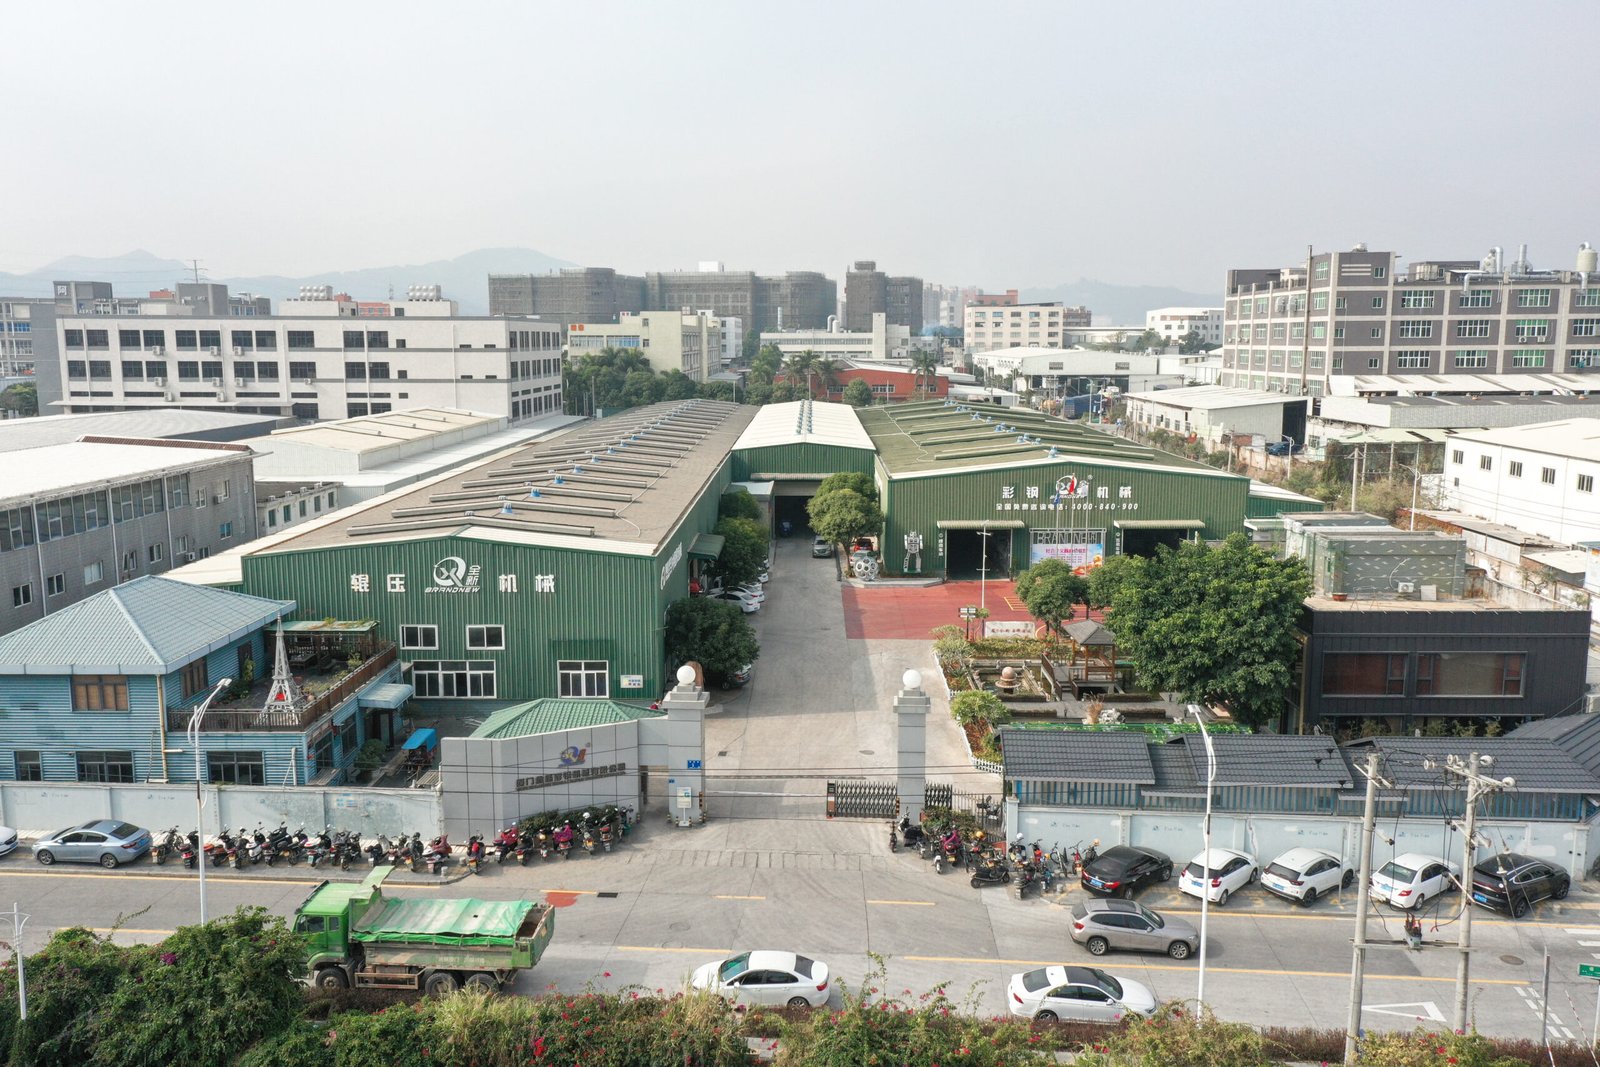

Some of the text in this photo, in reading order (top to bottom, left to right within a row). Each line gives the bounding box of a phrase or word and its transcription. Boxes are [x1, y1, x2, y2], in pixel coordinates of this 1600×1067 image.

[1002, 486, 1039, 499] 彩钢
[350, 573, 406, 594] 辊压
[465, 564, 481, 586] 全新
[499, 573, 556, 594] 机械
[424, 586, 481, 594] BRANDNEW
